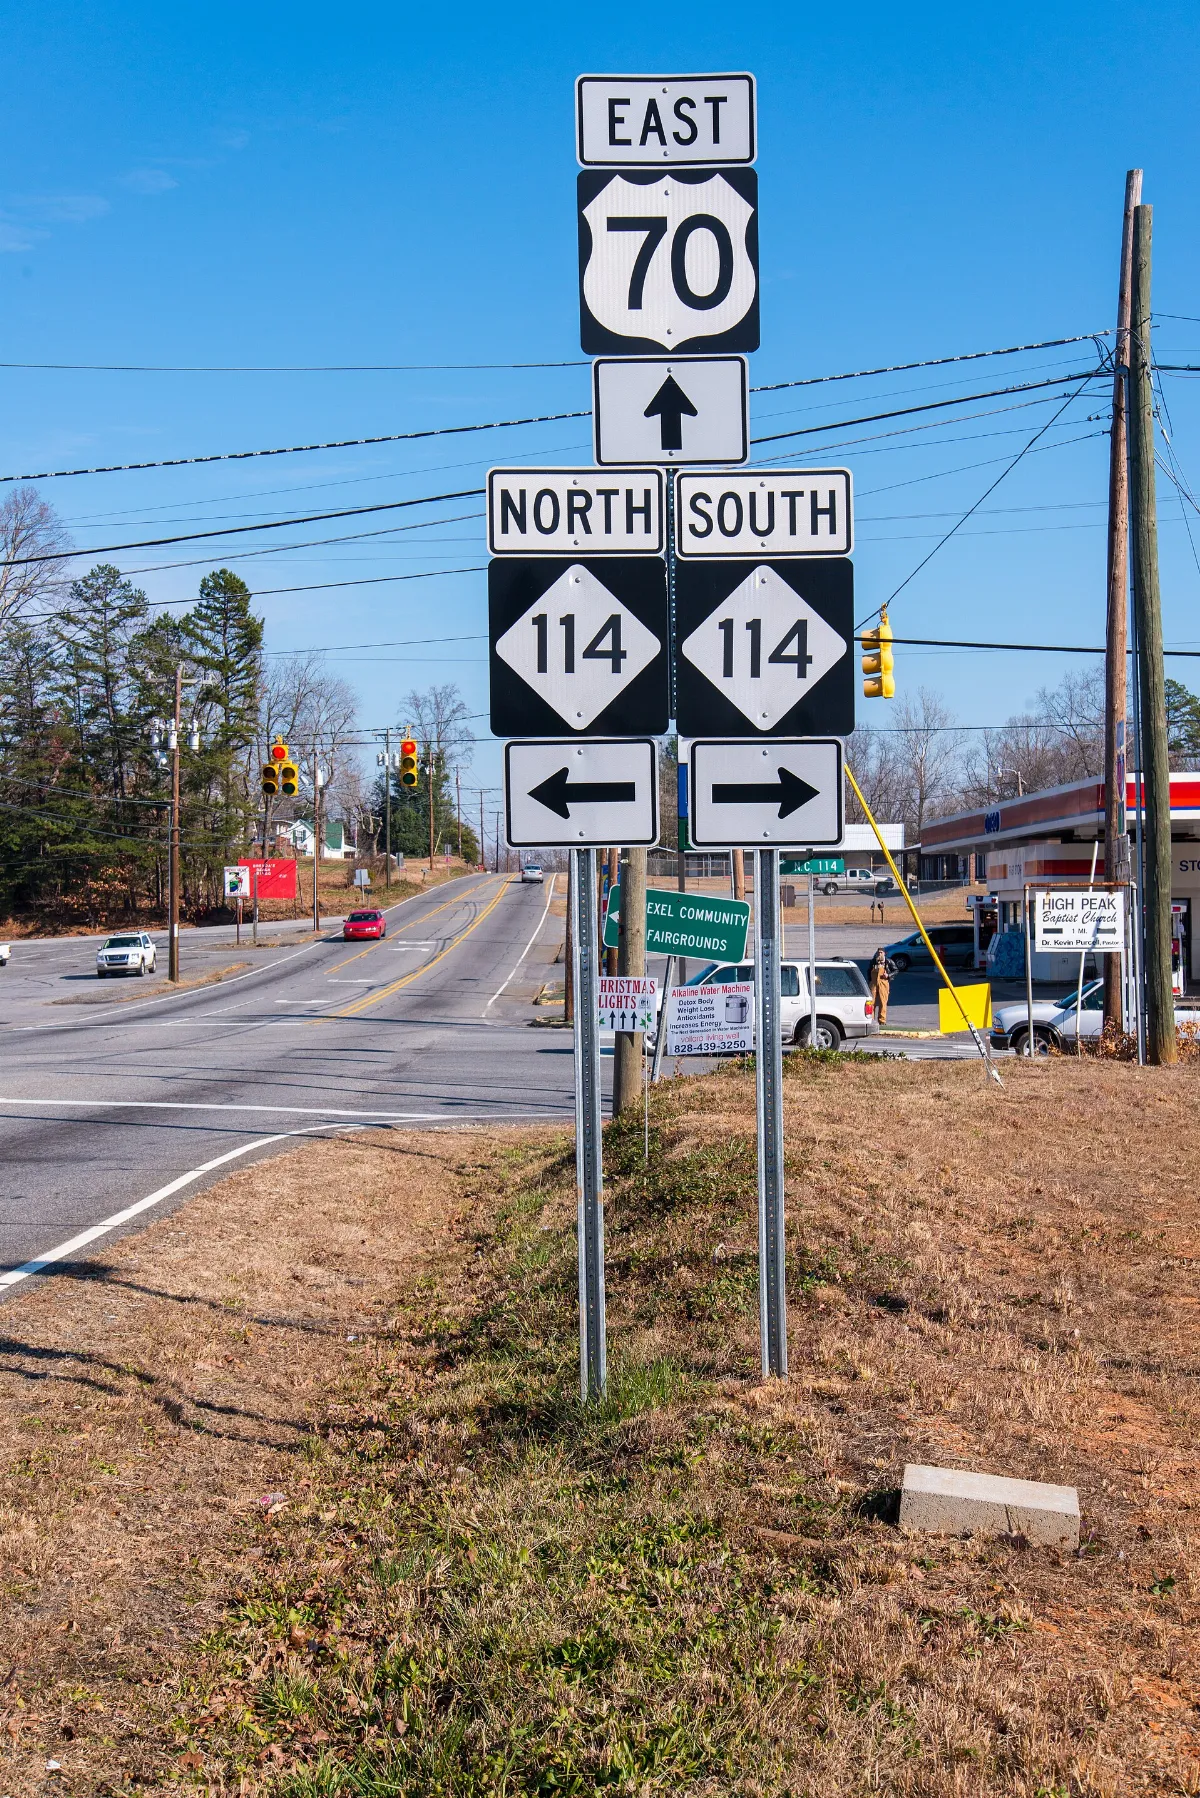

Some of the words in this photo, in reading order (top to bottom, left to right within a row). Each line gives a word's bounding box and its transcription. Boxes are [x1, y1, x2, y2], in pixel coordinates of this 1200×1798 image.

[607, 96, 728, 146] EAST
[606, 213, 734, 311] 70
[499, 488, 652, 535] NORTH
[688, 489, 837, 539] SOUTH
[531, 613, 627, 674] 114
[718, 618, 813, 679] 114
[794, 861, 813, 872] N.C.
[818, 860, 837, 872] 114
[1042, 898, 1074, 910] HIGH
[1081, 898, 1117, 910] PEAK
[646, 902, 674, 917] EXEL
[679, 906, 748, 927] COMMUNITY
[1041, 910, 1079, 925] Baptist
[1081, 910, 1118, 924] Church
[647, 929, 728, 952] FAIRGROUNDS
[600, 979, 656, 994] HRISTMAS
[671, 988, 699, 998] Alkaline
[700, 986, 720, 996] Water
[721, 984, 751, 994] Machine
[598, 994, 637, 1009] LIGHTS
[677, 1006, 699, 1014] Weight
[677, 1013, 715, 1021] Antioxidants
[700, 1020, 722, 1028] Energy
[706, 1033, 724, 1042] living
[726, 1032, 740, 1040] well
[674, 1040, 746, 1054] 828-439-3250
